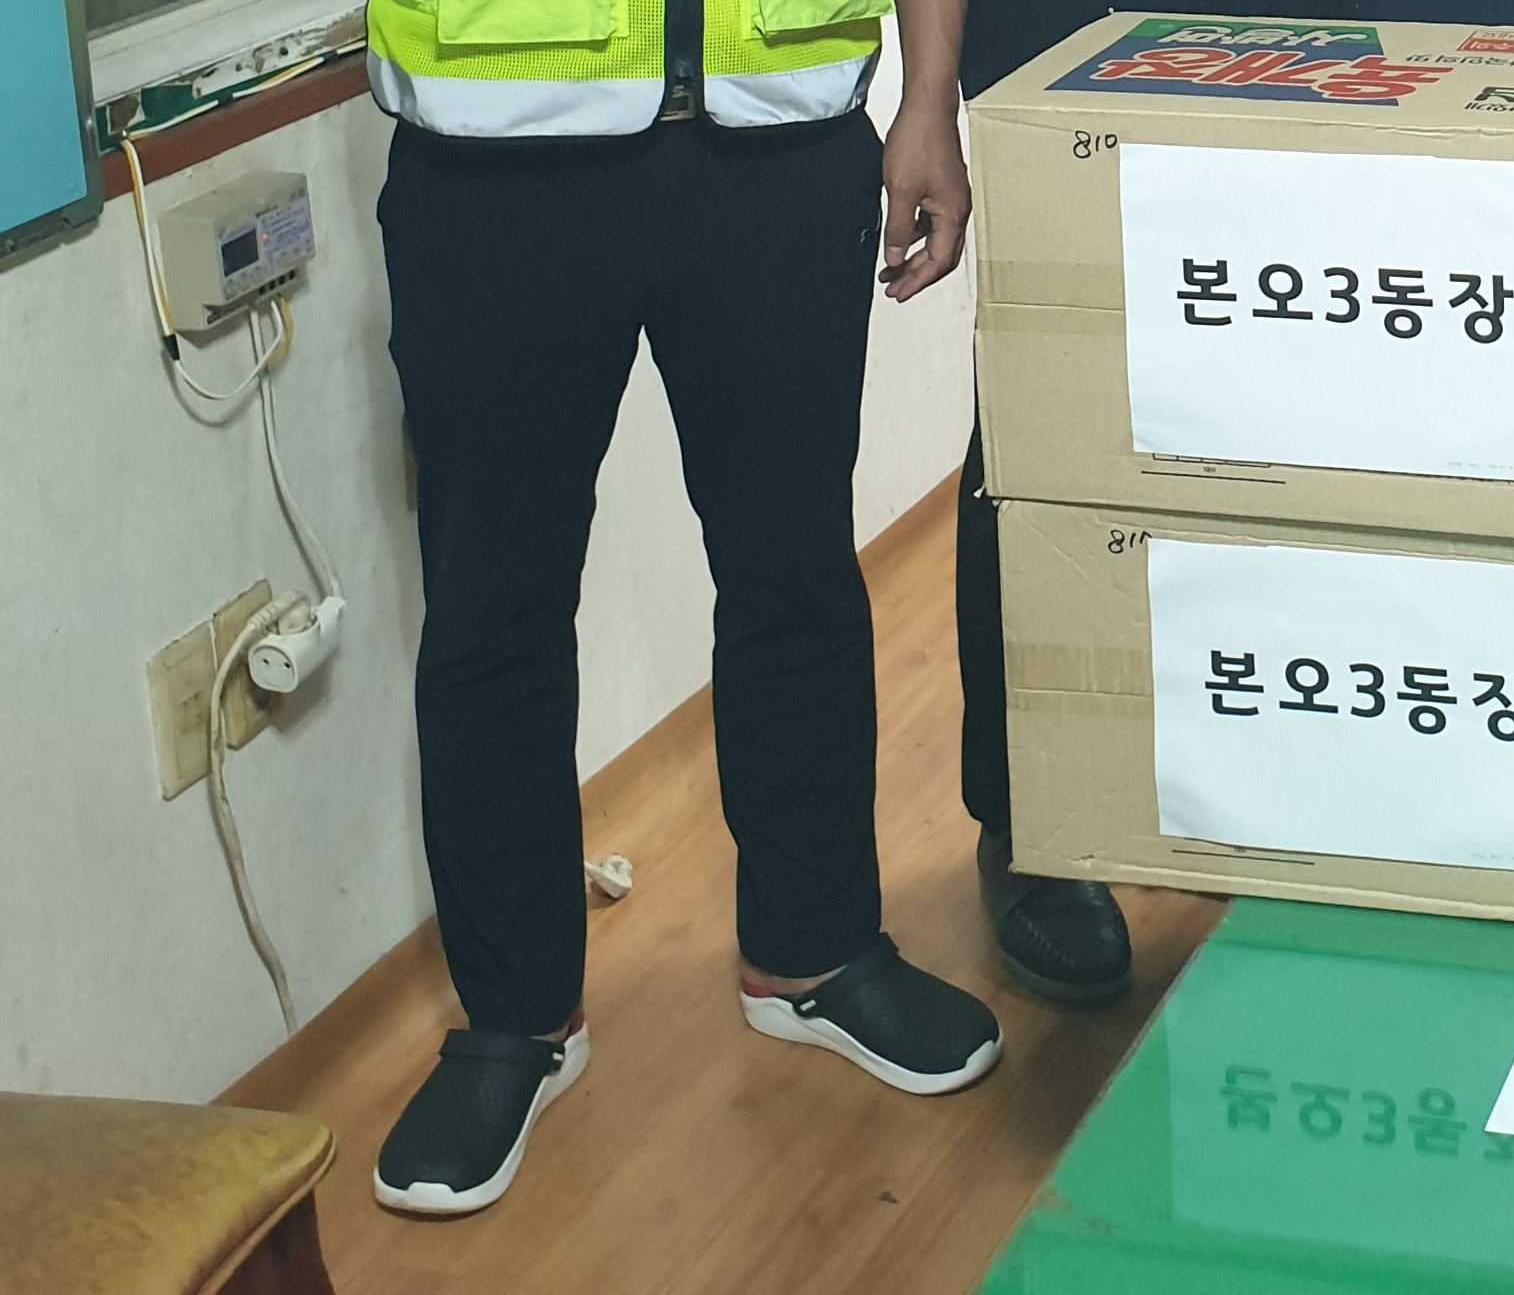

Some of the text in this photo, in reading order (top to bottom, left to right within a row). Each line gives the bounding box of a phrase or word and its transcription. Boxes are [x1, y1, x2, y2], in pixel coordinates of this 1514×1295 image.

[1089, 47, 1455, 100] 육개장
[1072, 131, 1118, 159] 810
[1176, 258, 1514, 344] 본오3동장
